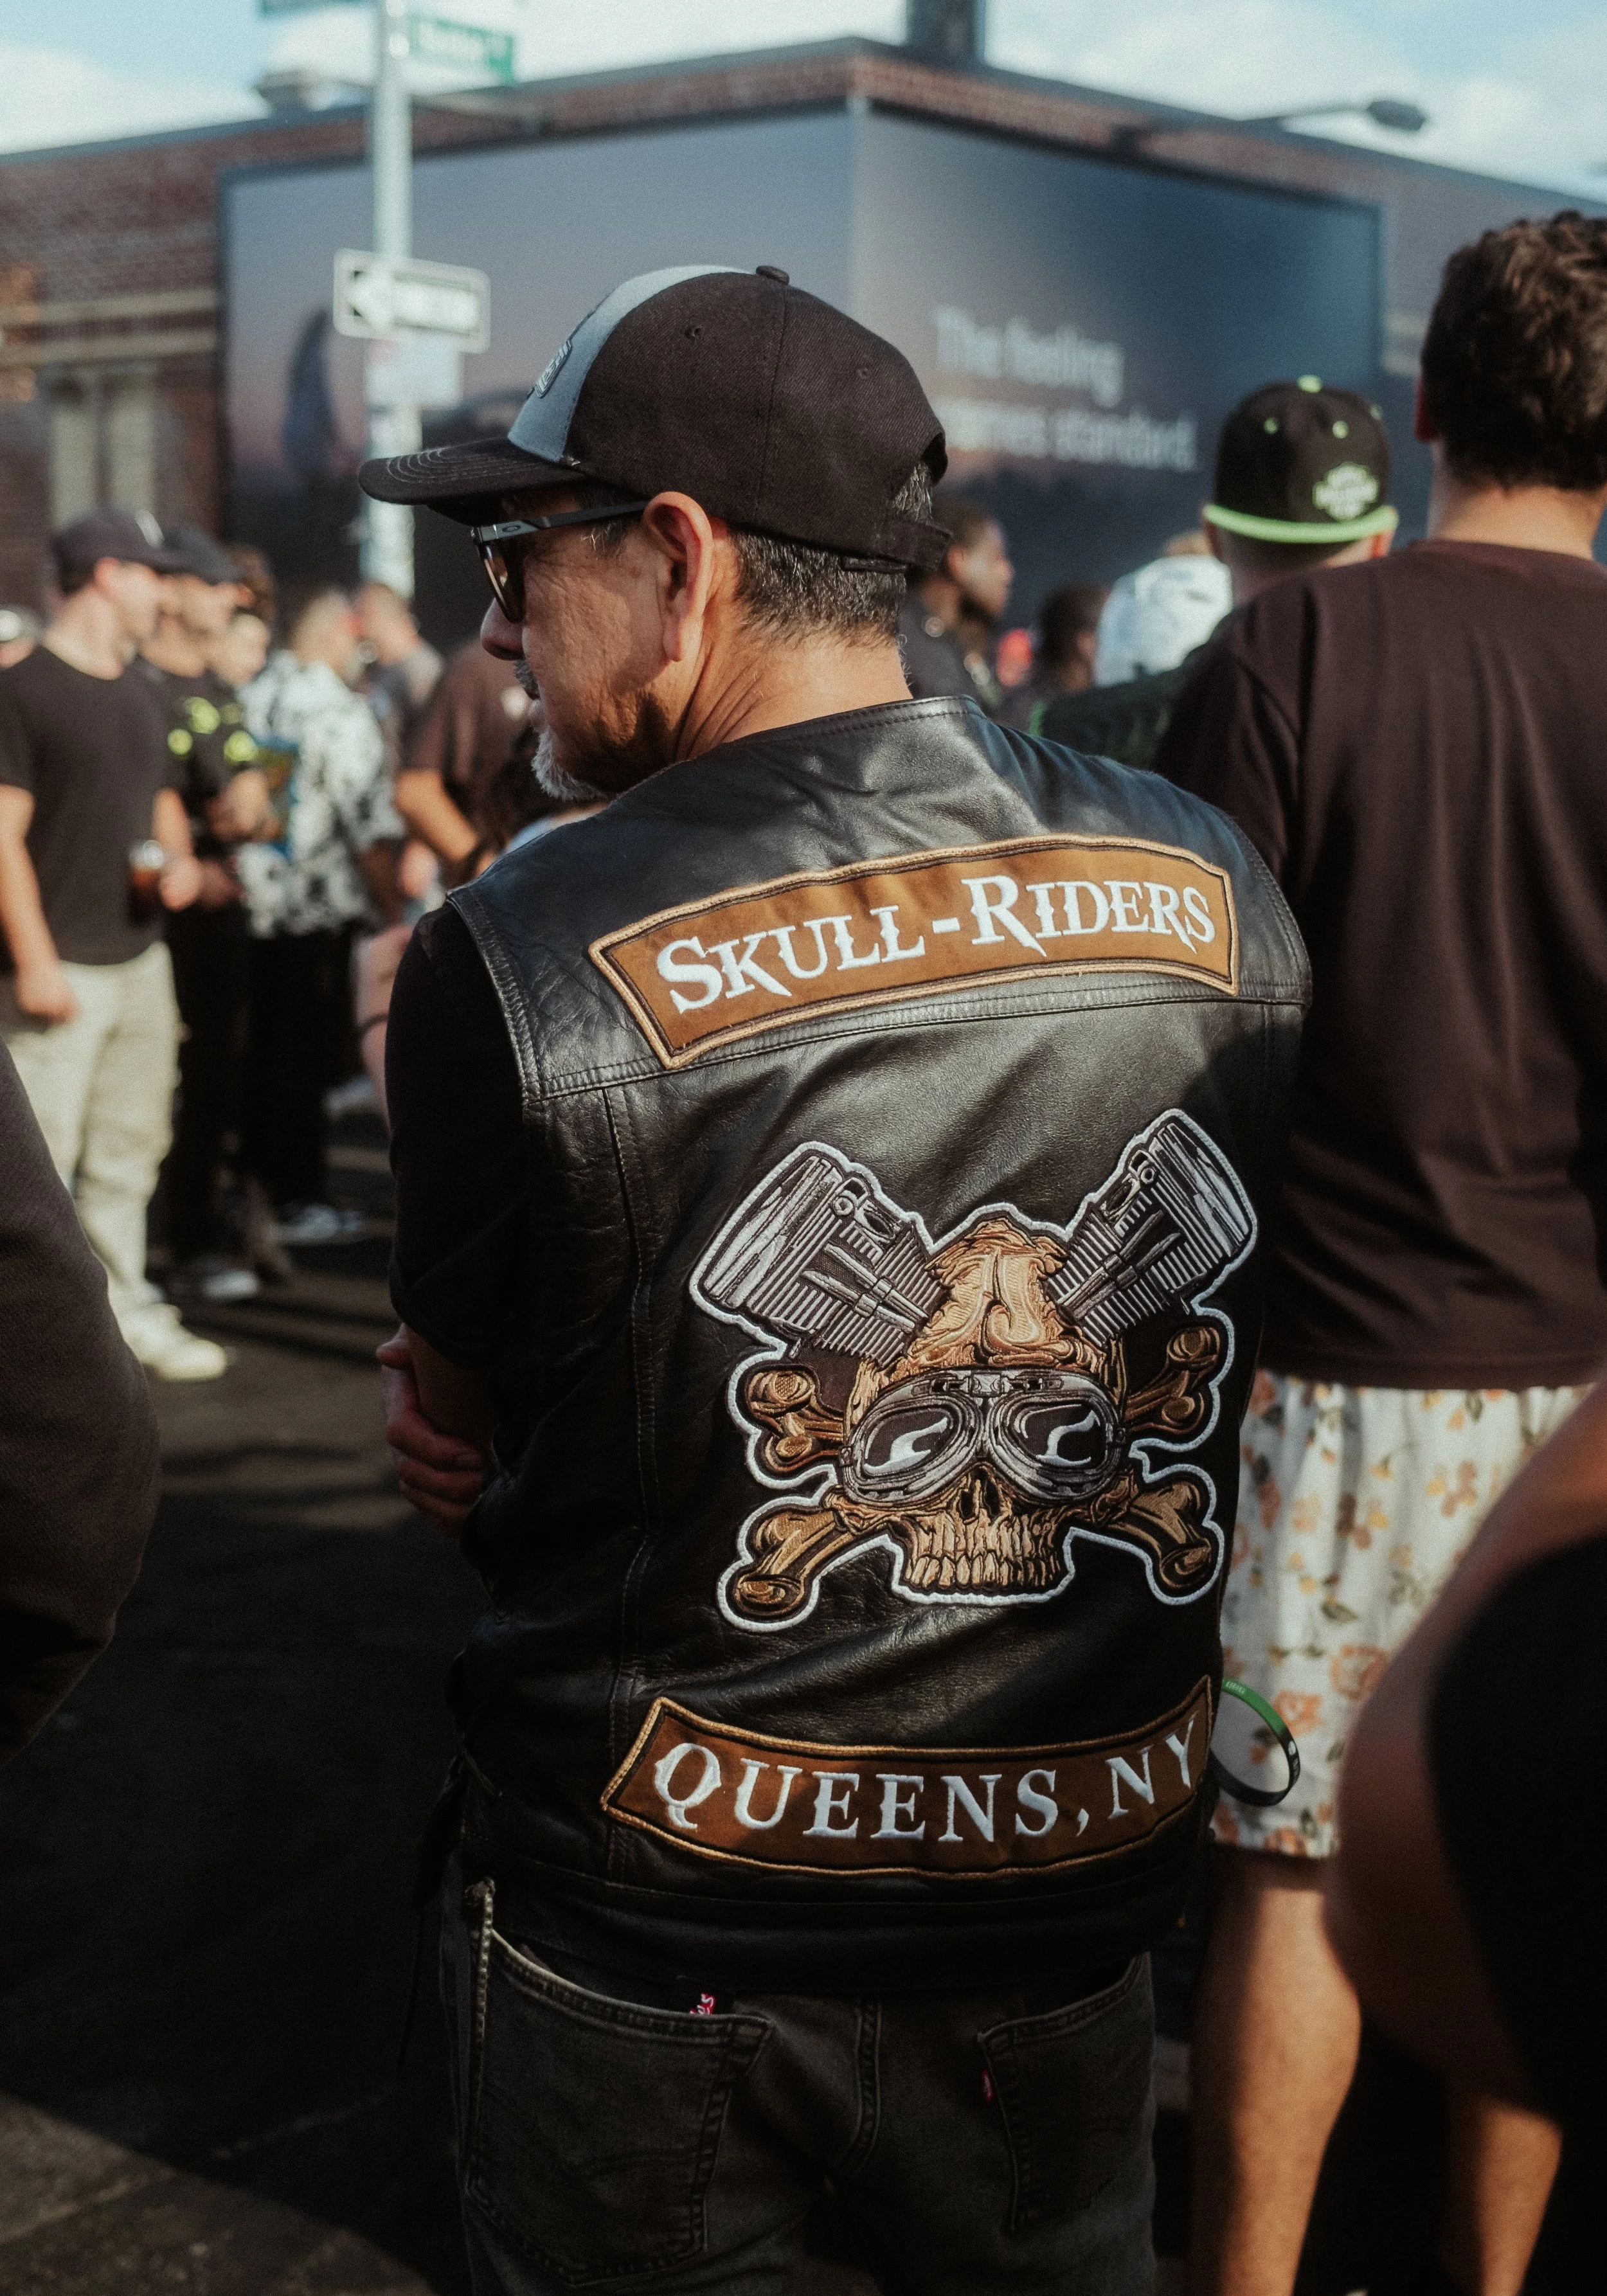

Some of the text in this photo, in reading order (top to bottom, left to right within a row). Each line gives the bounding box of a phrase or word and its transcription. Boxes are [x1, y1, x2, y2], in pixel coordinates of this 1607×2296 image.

[937, 307, 1002, 378] The
[654, 1710, 1199, 1842] QUEENS, NY
